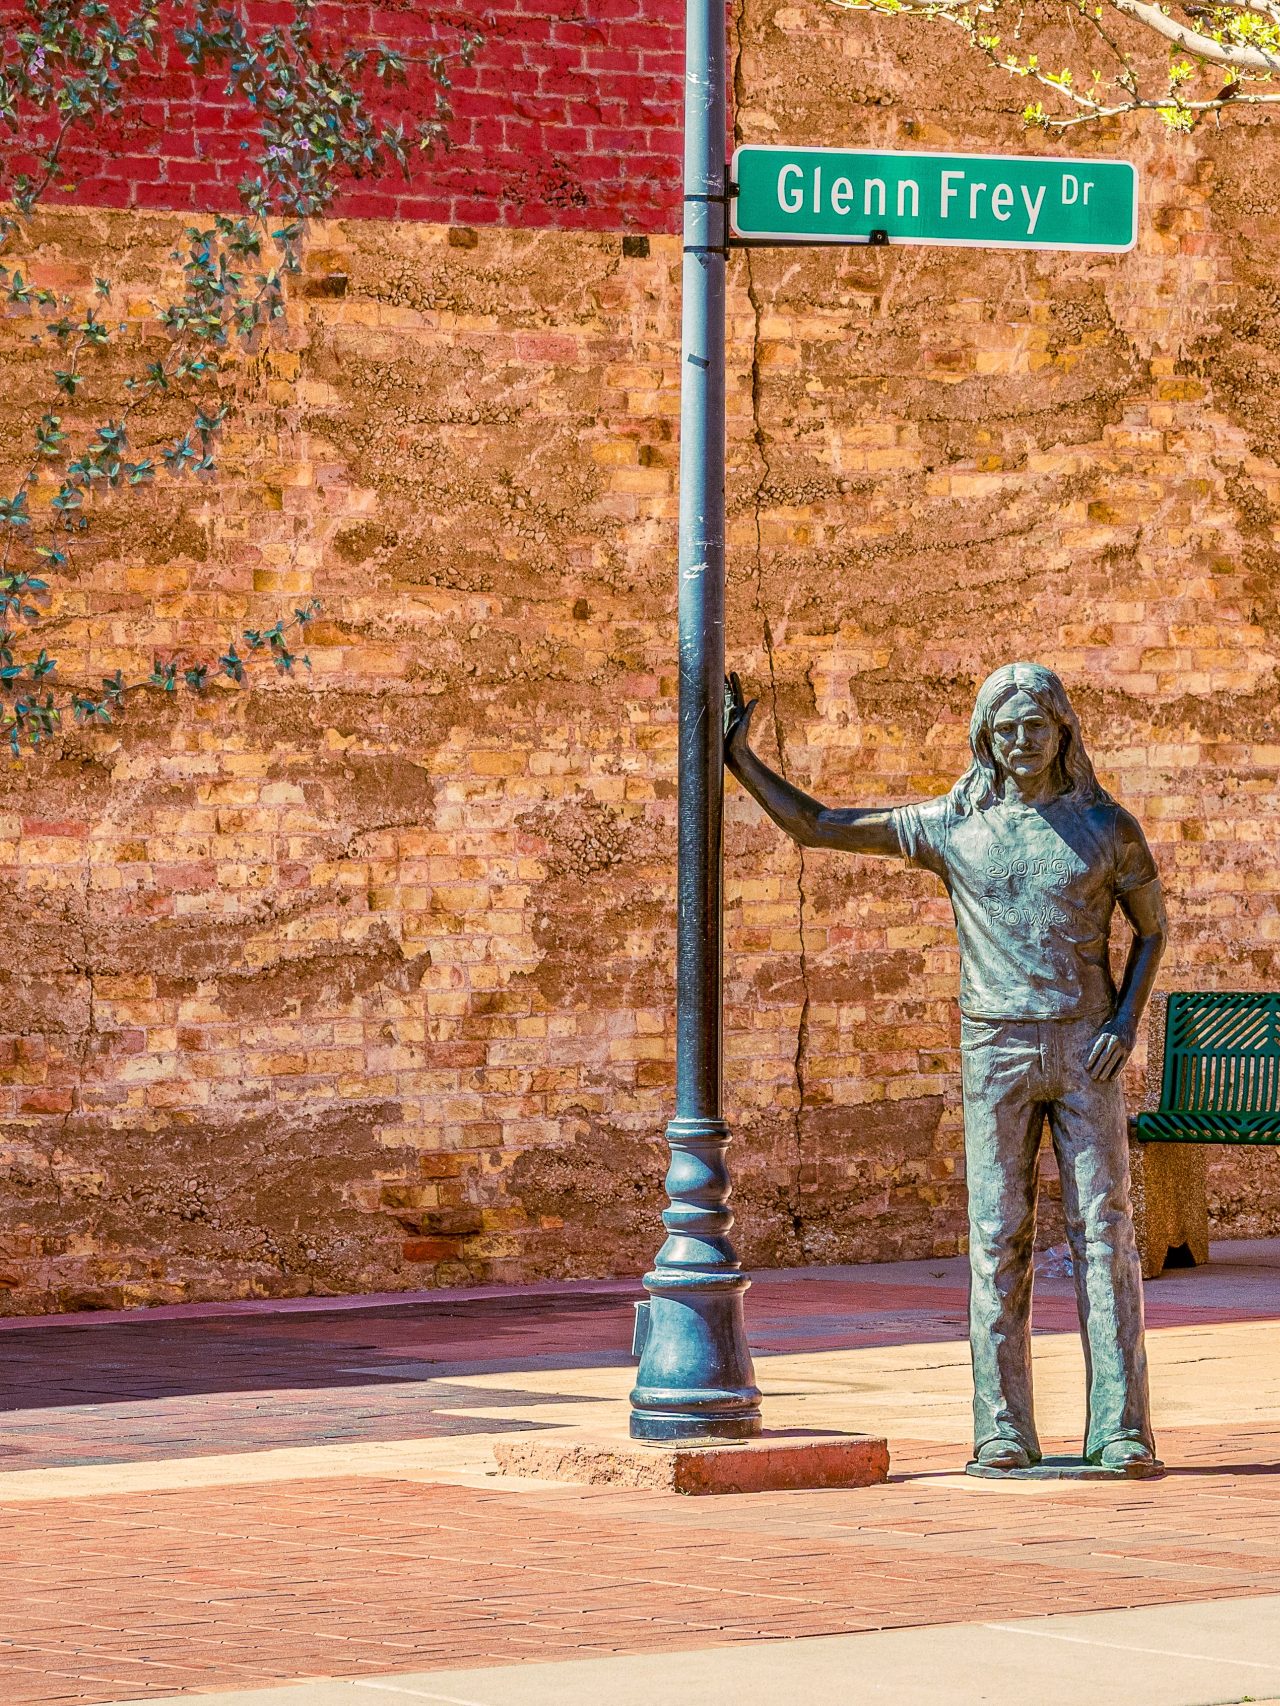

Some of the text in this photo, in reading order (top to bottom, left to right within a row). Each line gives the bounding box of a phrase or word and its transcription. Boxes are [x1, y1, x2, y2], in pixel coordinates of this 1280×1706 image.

[777, 162, 1095, 235] Glenn Frey Dr
[986, 842, 1072, 888] Song
